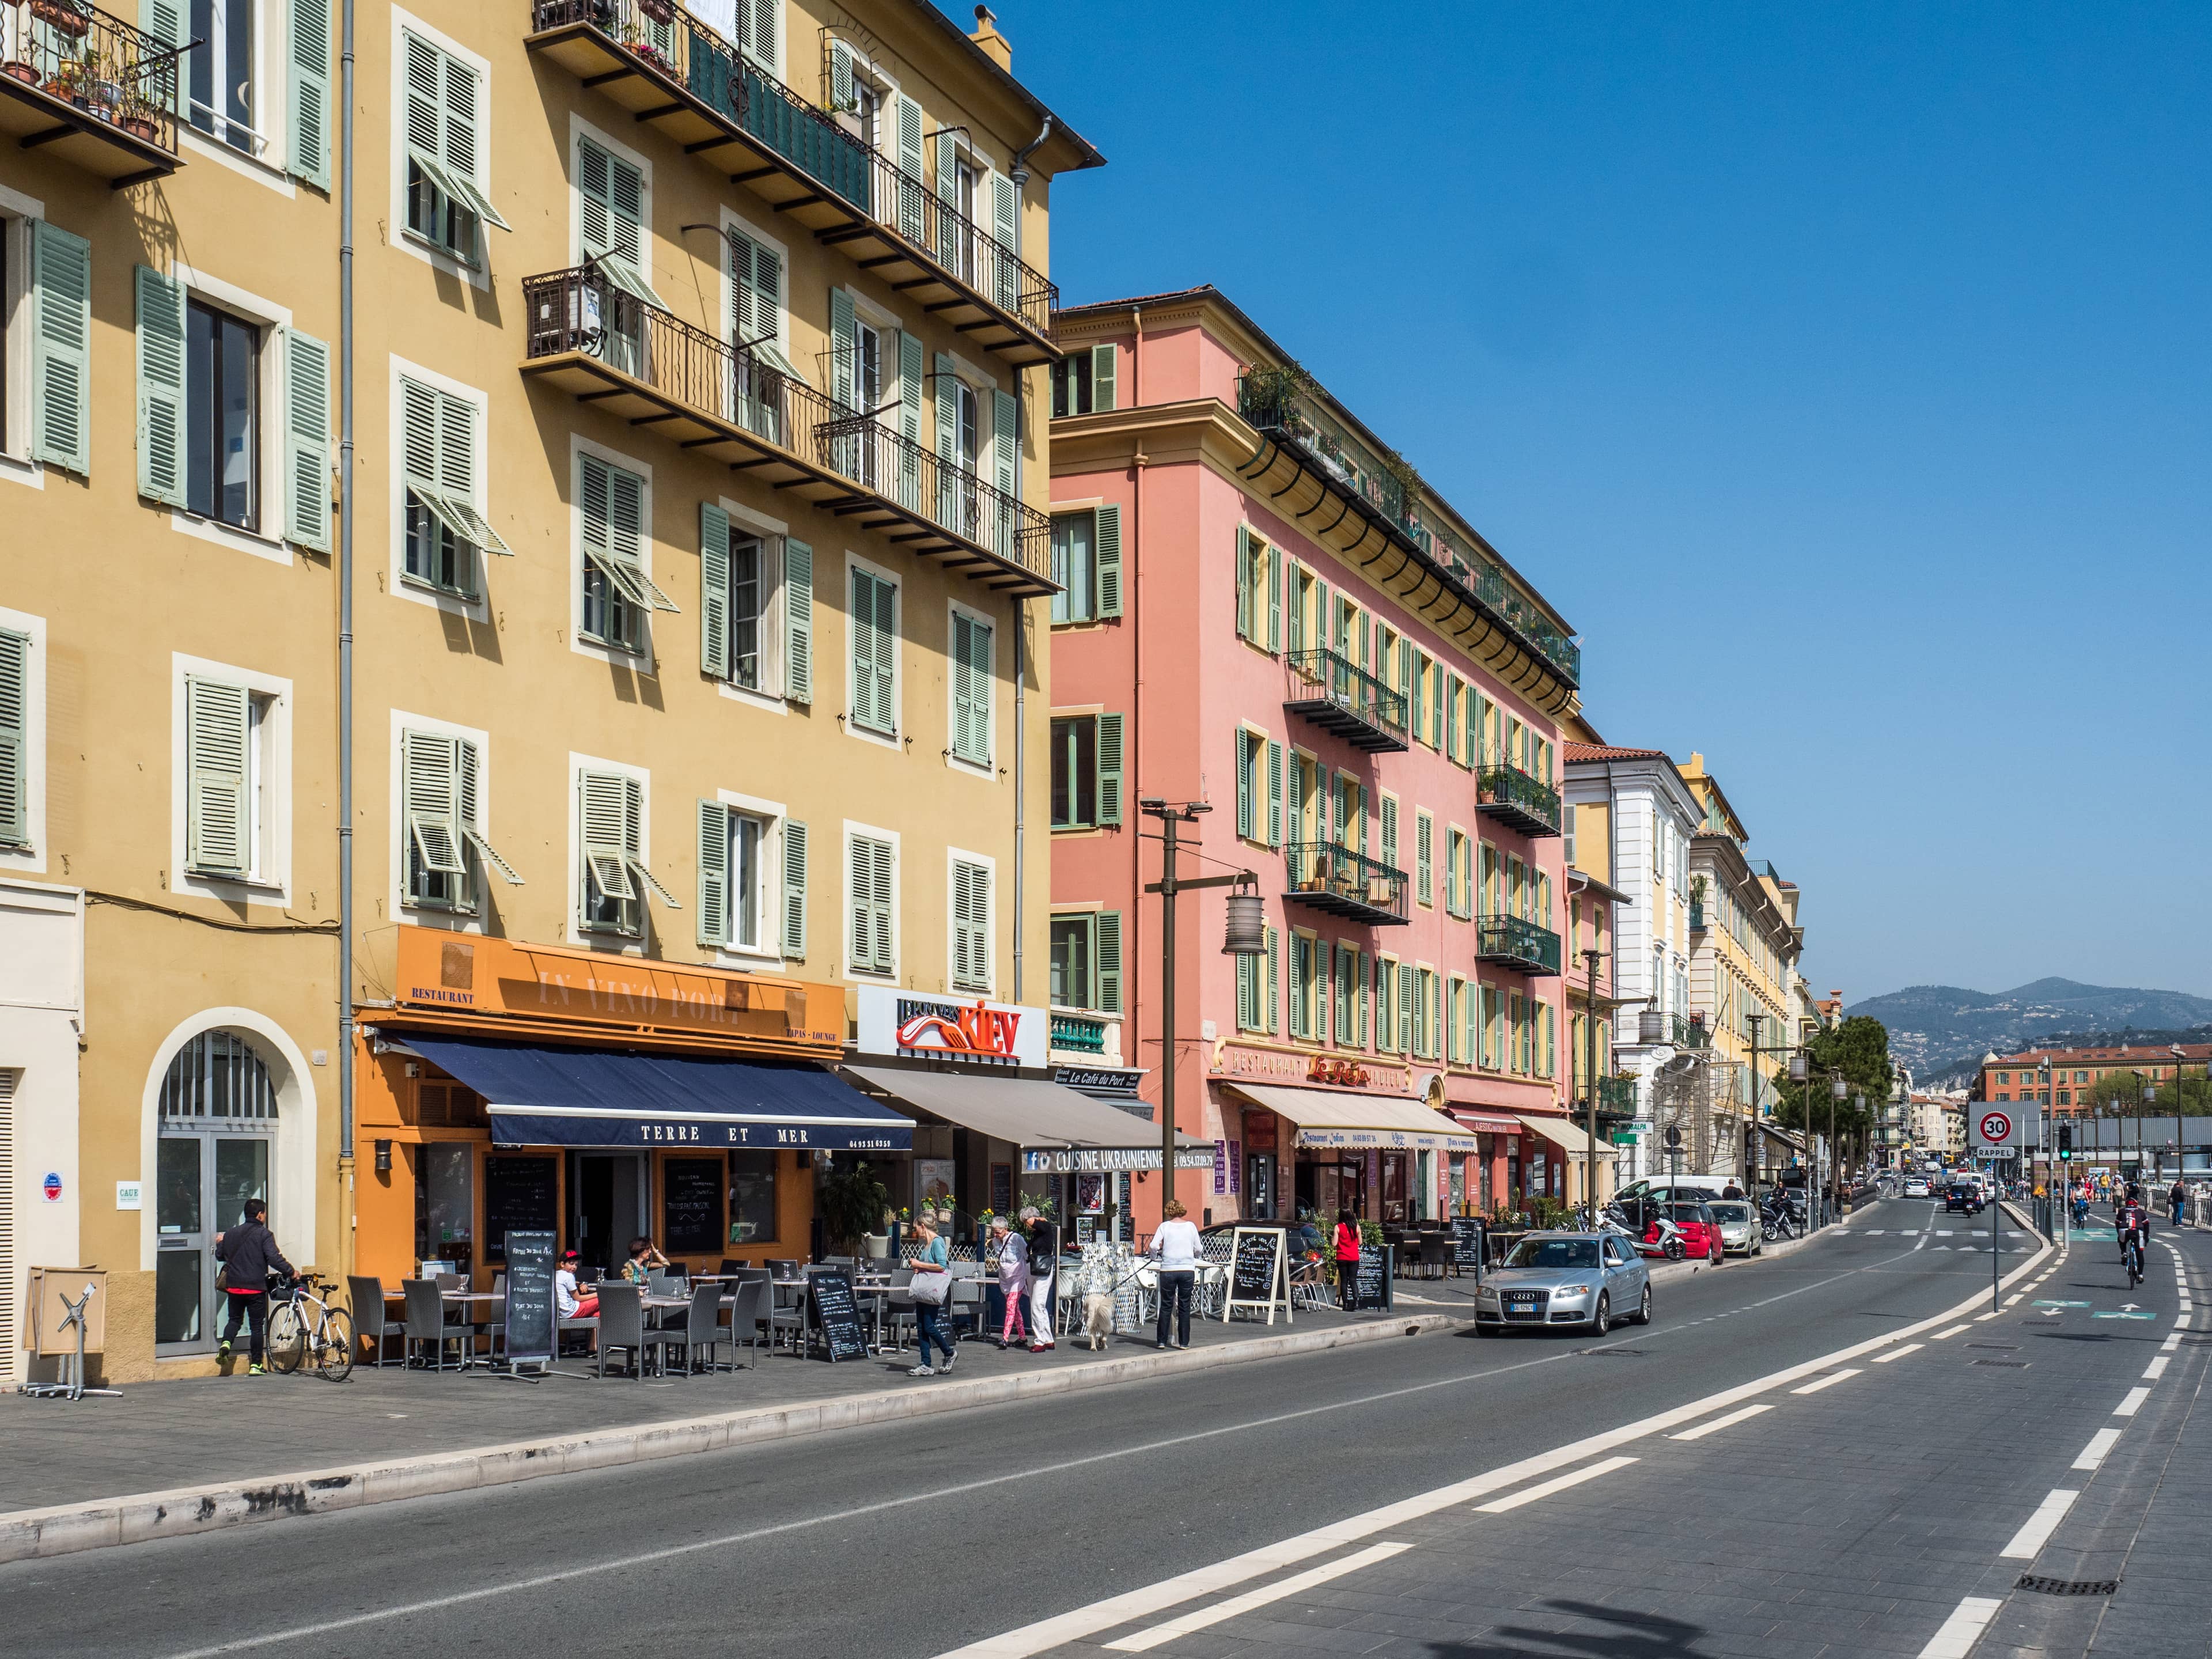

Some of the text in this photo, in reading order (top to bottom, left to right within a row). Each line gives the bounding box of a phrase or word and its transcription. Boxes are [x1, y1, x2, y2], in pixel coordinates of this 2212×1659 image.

[412, 987, 474, 1004] RESTAURANT
[539, 971, 571, 1005] IN
[586, 978, 658, 1016] VINO
[787, 1028, 806, 1038] TAPAS
[812, 1032, 836, 1042] LOUNGE
[1233, 1051, 1302, 1077] RESTAURANT
[1070, 1072, 1125, 1086] Le Café du Port
[1369, 1069, 1400, 1088] INDIEN
[641, 1125, 808, 1143] TERRE ET MER
[1986, 1120, 2005, 1134] 30
[1056, 1150, 1099, 1171] CUISINE
